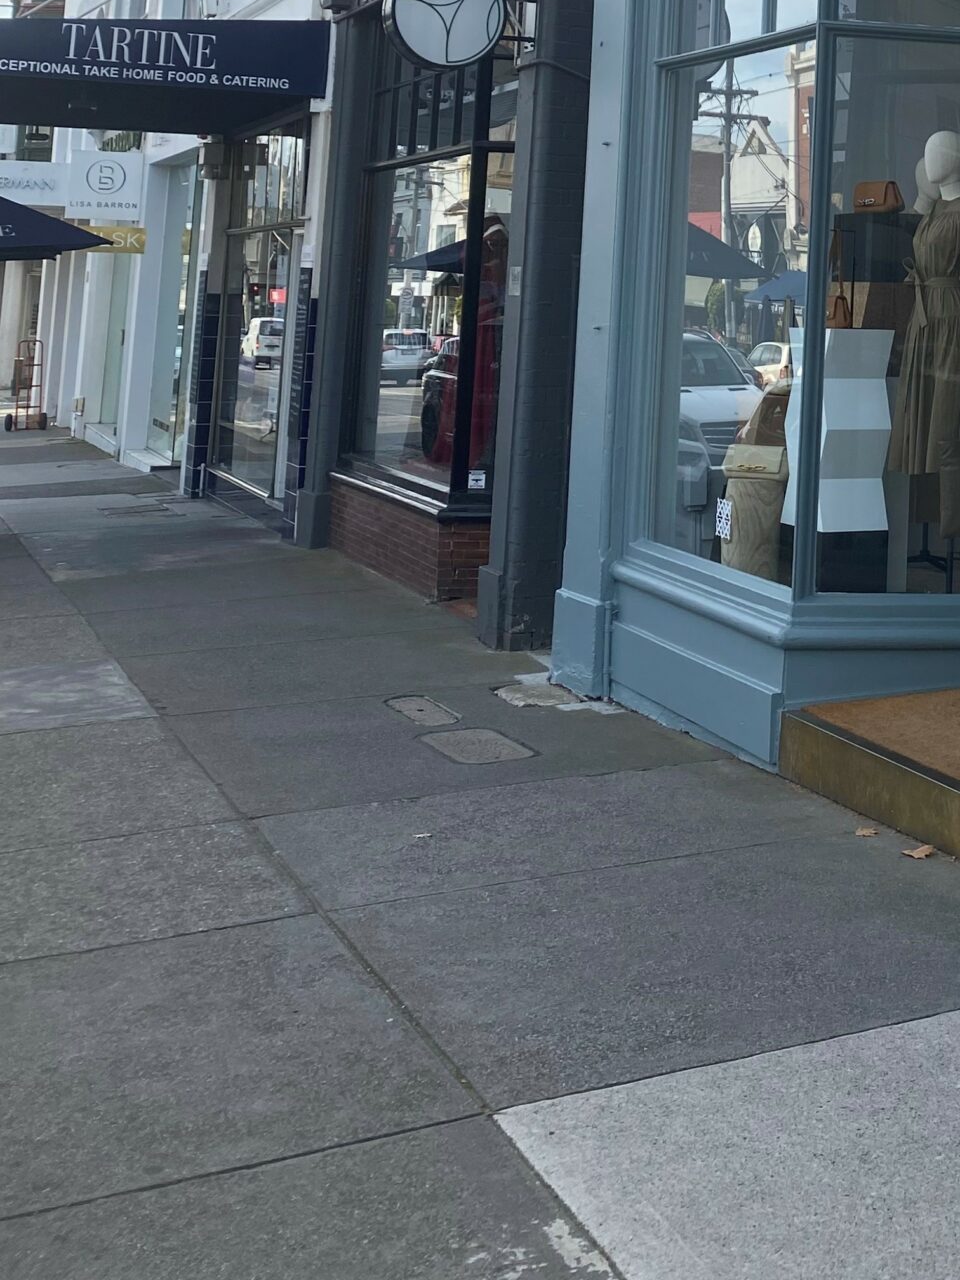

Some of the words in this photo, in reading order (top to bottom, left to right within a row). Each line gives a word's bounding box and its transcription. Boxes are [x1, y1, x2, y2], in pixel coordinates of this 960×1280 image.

[61, 22, 217, 70] TARTINE
[83, 64, 119, 78] TAKE
[123, 68, 163, 81] HOME
[168, 71, 206, 84] FOOD
[209, 74, 219, 84] &
[222, 74, 290, 89] CATERING
[96, 201, 138, 209] BARRON
